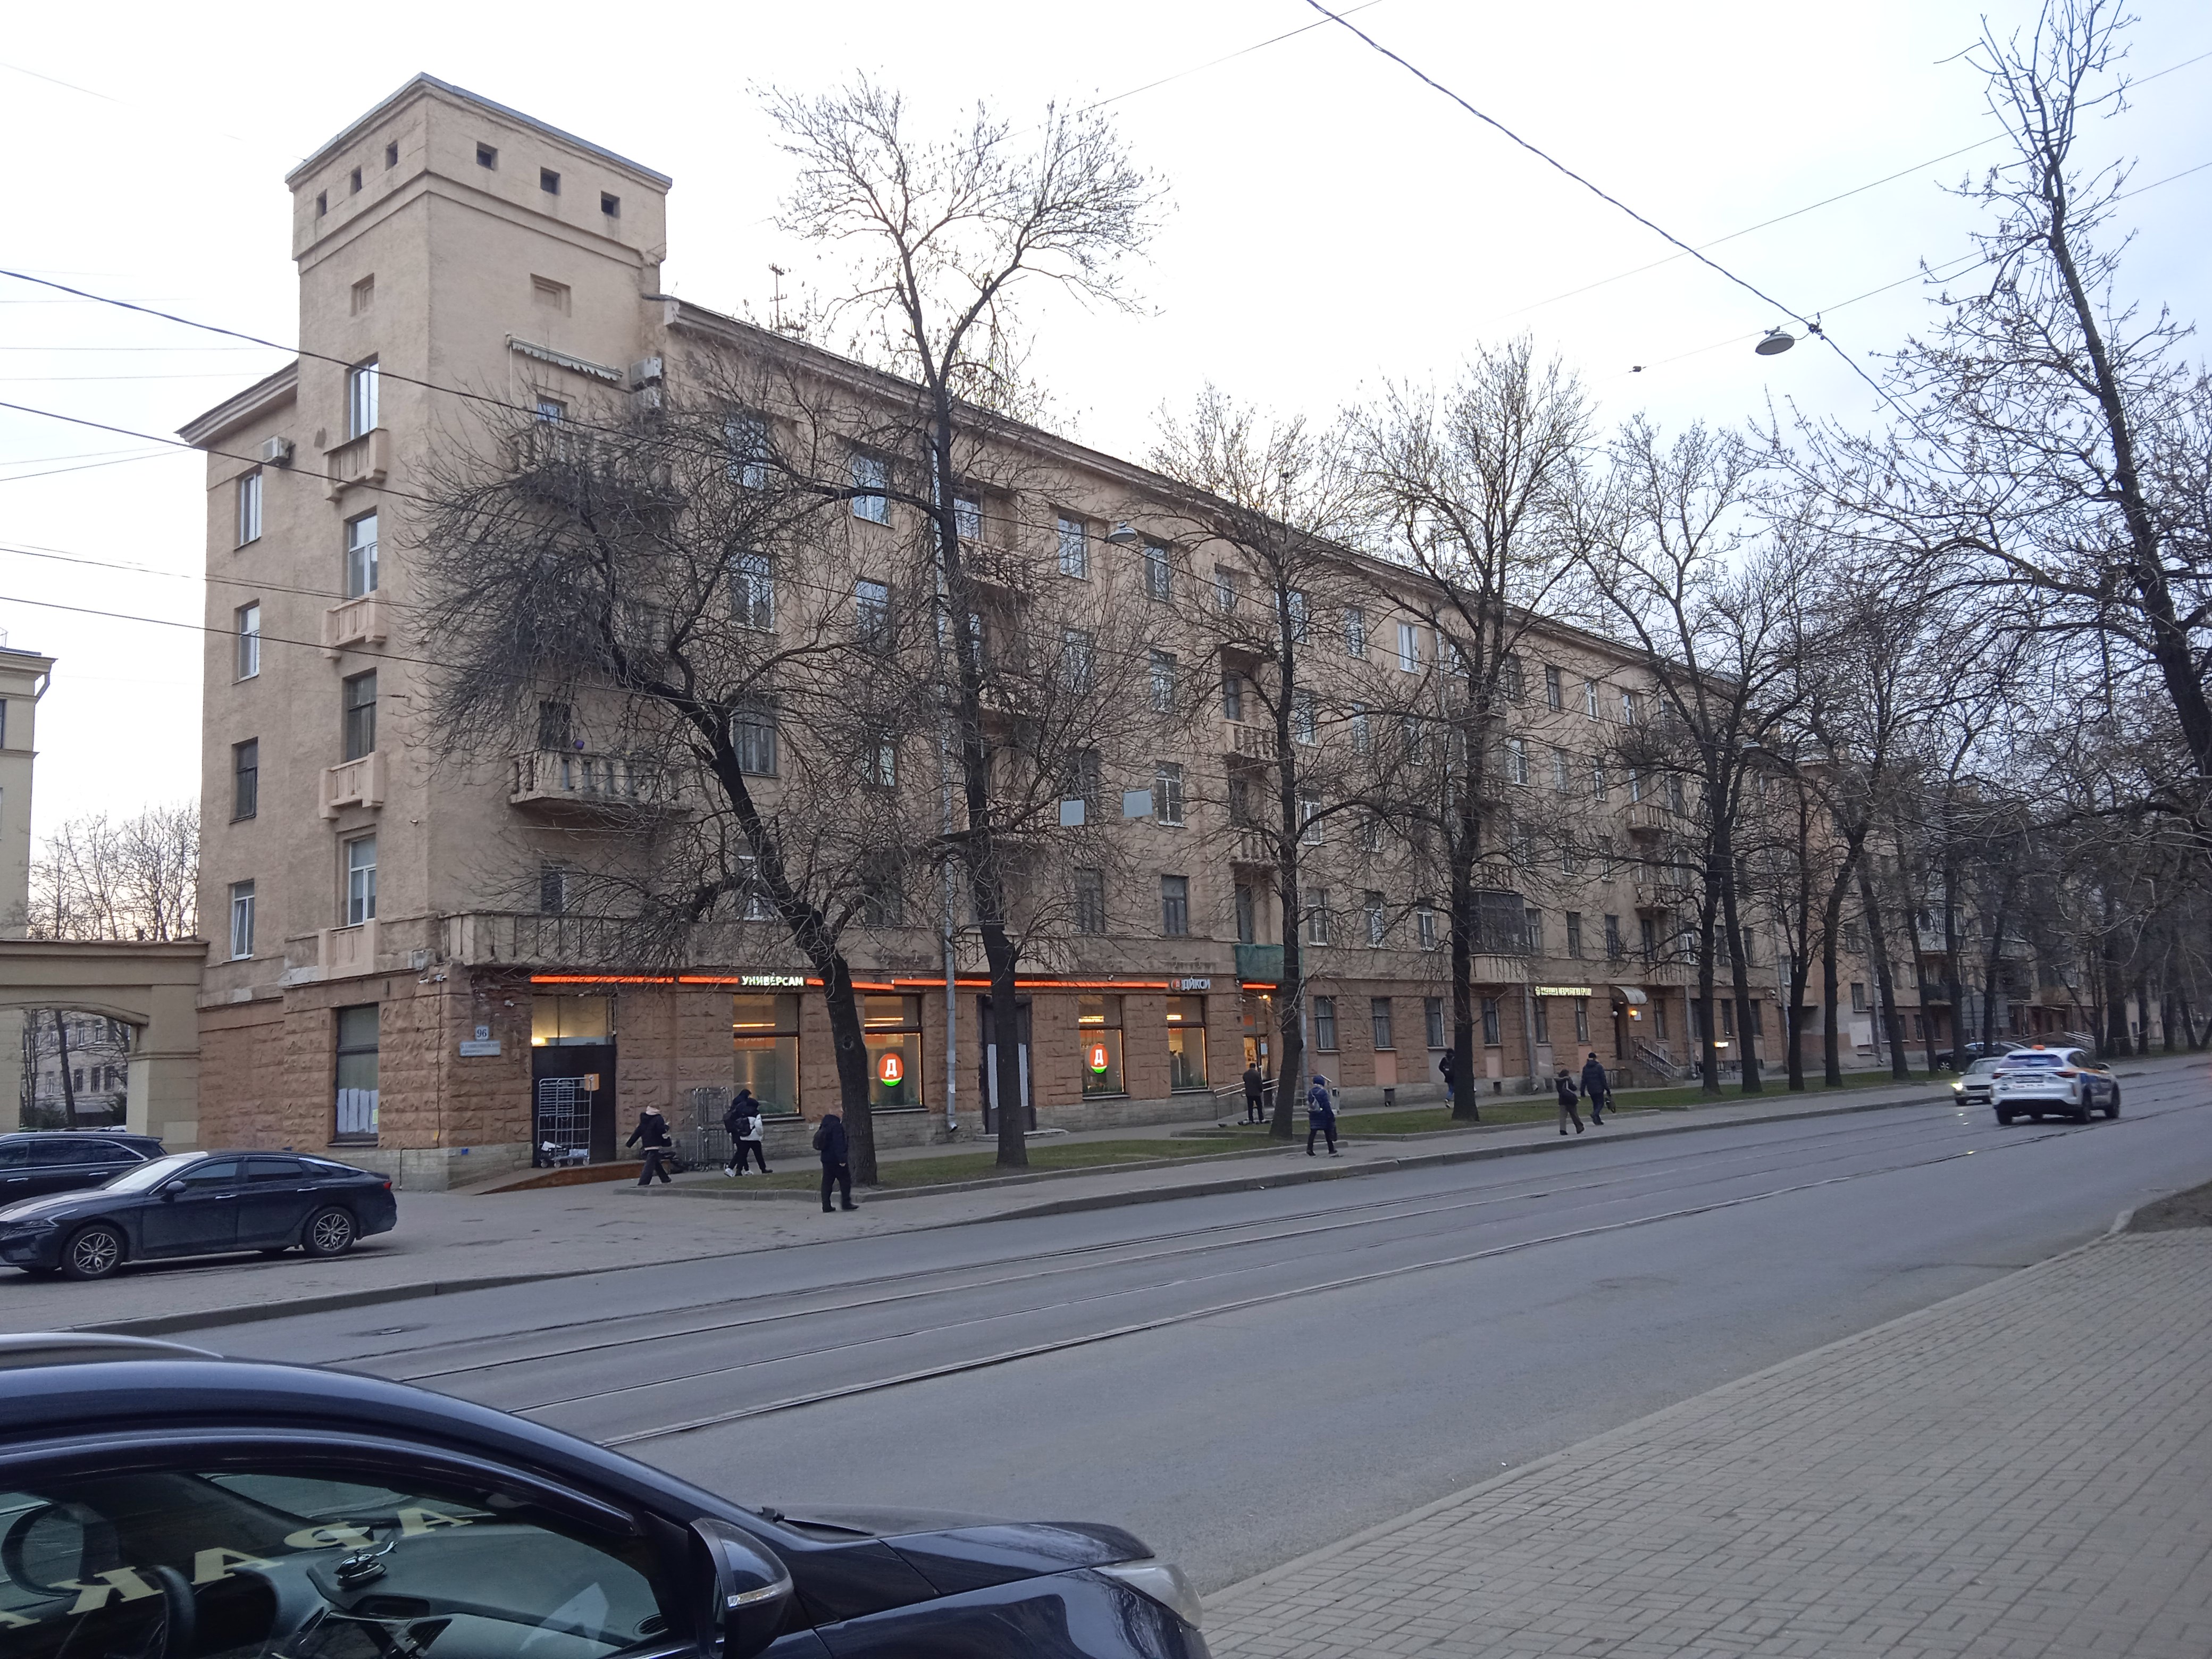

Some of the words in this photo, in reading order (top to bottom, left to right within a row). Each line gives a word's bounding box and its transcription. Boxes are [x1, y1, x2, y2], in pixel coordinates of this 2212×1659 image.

[741, 975, 804, 986] УНИВЕРСАМ
[1181, 979, 1211, 991] ДИКСИ
[476, 1028, 487, 1037] 96
[1094, 1049, 1104, 1066] Д
[885, 1059, 898, 1077] Д
